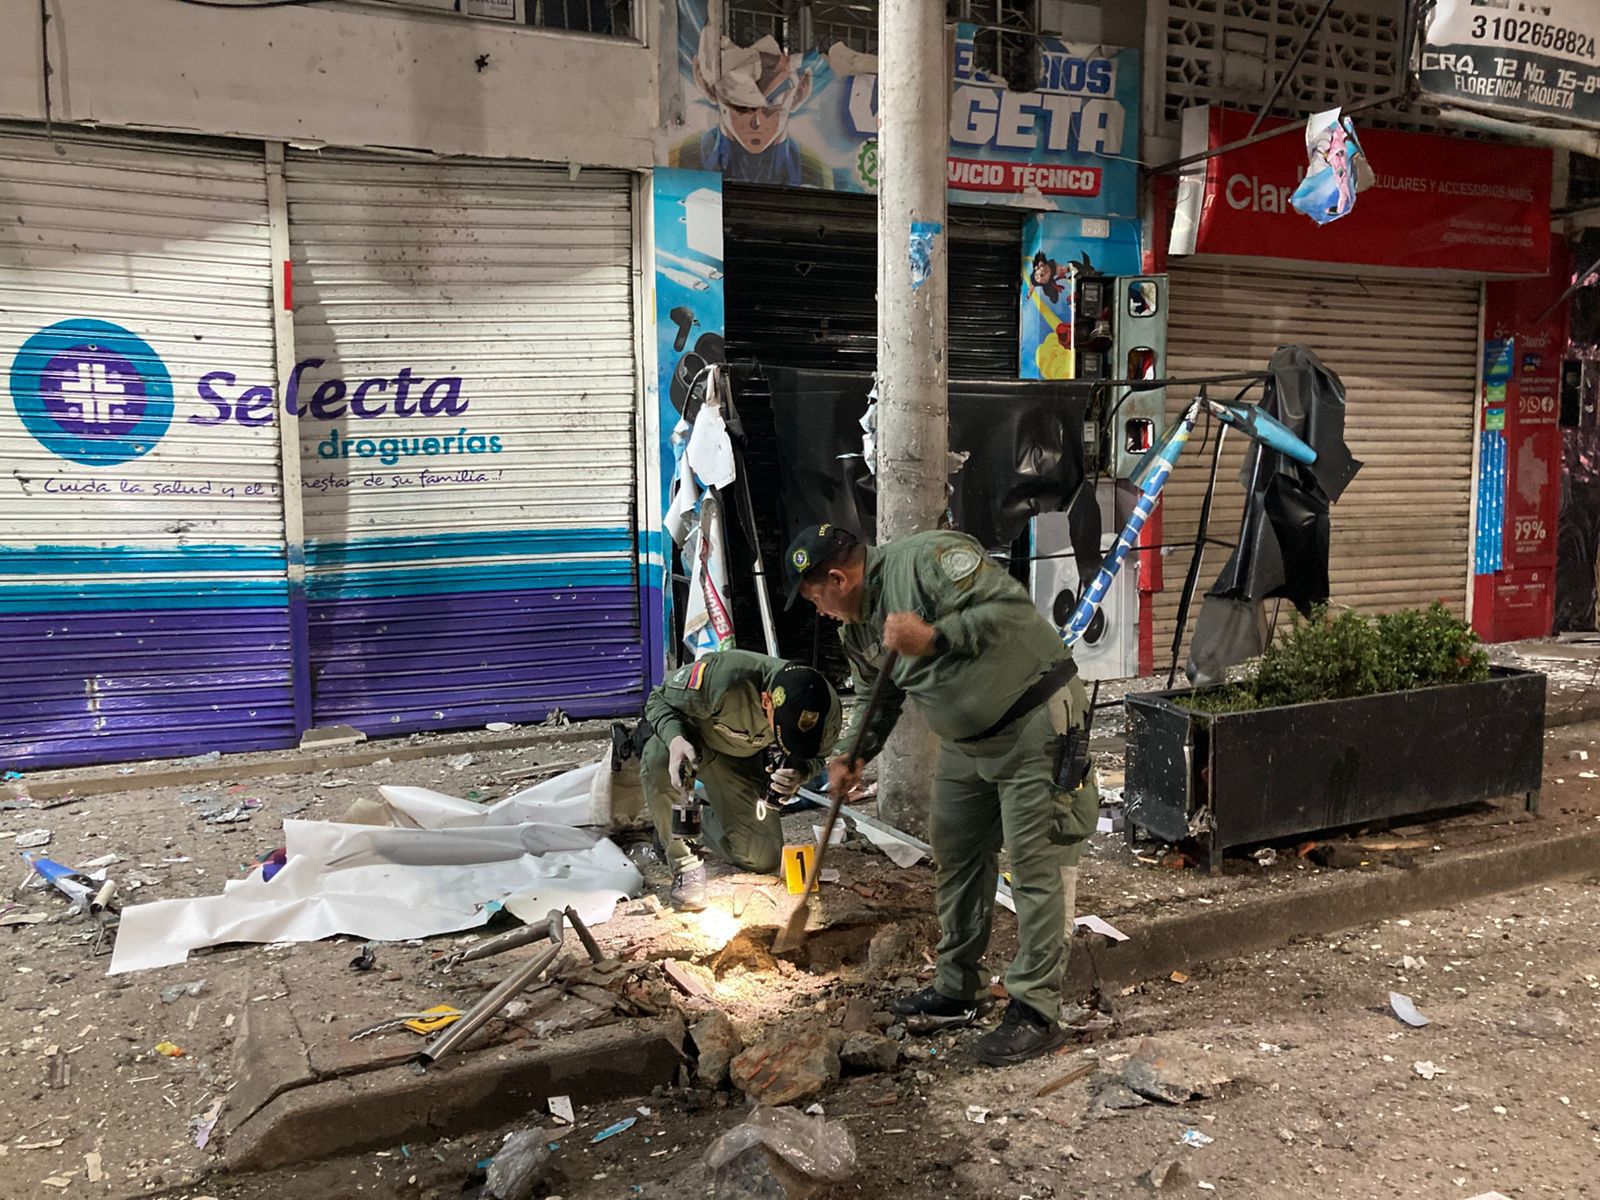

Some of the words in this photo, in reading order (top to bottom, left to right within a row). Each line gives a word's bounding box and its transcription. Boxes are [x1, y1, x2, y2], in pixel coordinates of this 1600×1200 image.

[1471, 15, 1596, 60] 3102658824
[1421, 52, 1479, 75] CRA.
[1493, 57, 1518, 79] 12
[1523, 62, 1546, 84] No.
[1454, 74, 1520, 100] FLORENCIA
[849, 74, 1125, 154] VGETA
[948, 161, 1004, 186] VICIO
[1012, 163, 1095, 190] TÉCNICO
[1375, 174, 1427, 192] LULARES
[1429, 179, 1437, 193] Y
[1438, 180, 1505, 200] ACCESORIOS
[1226, 173, 1304, 215] Clar
[187, 357, 471, 427] Selecta
[318, 427, 503, 466] droguerías
[44, 477, 111, 495] Cuida
[120, 479, 144, 494] la
[153, 480, 212, 495] salud
[221, 486, 235, 498] y
[244, 481, 264, 496] el
[363, 473, 385, 487] de
[391, 475, 413, 488] su
[796, 851, 807, 885] 1
